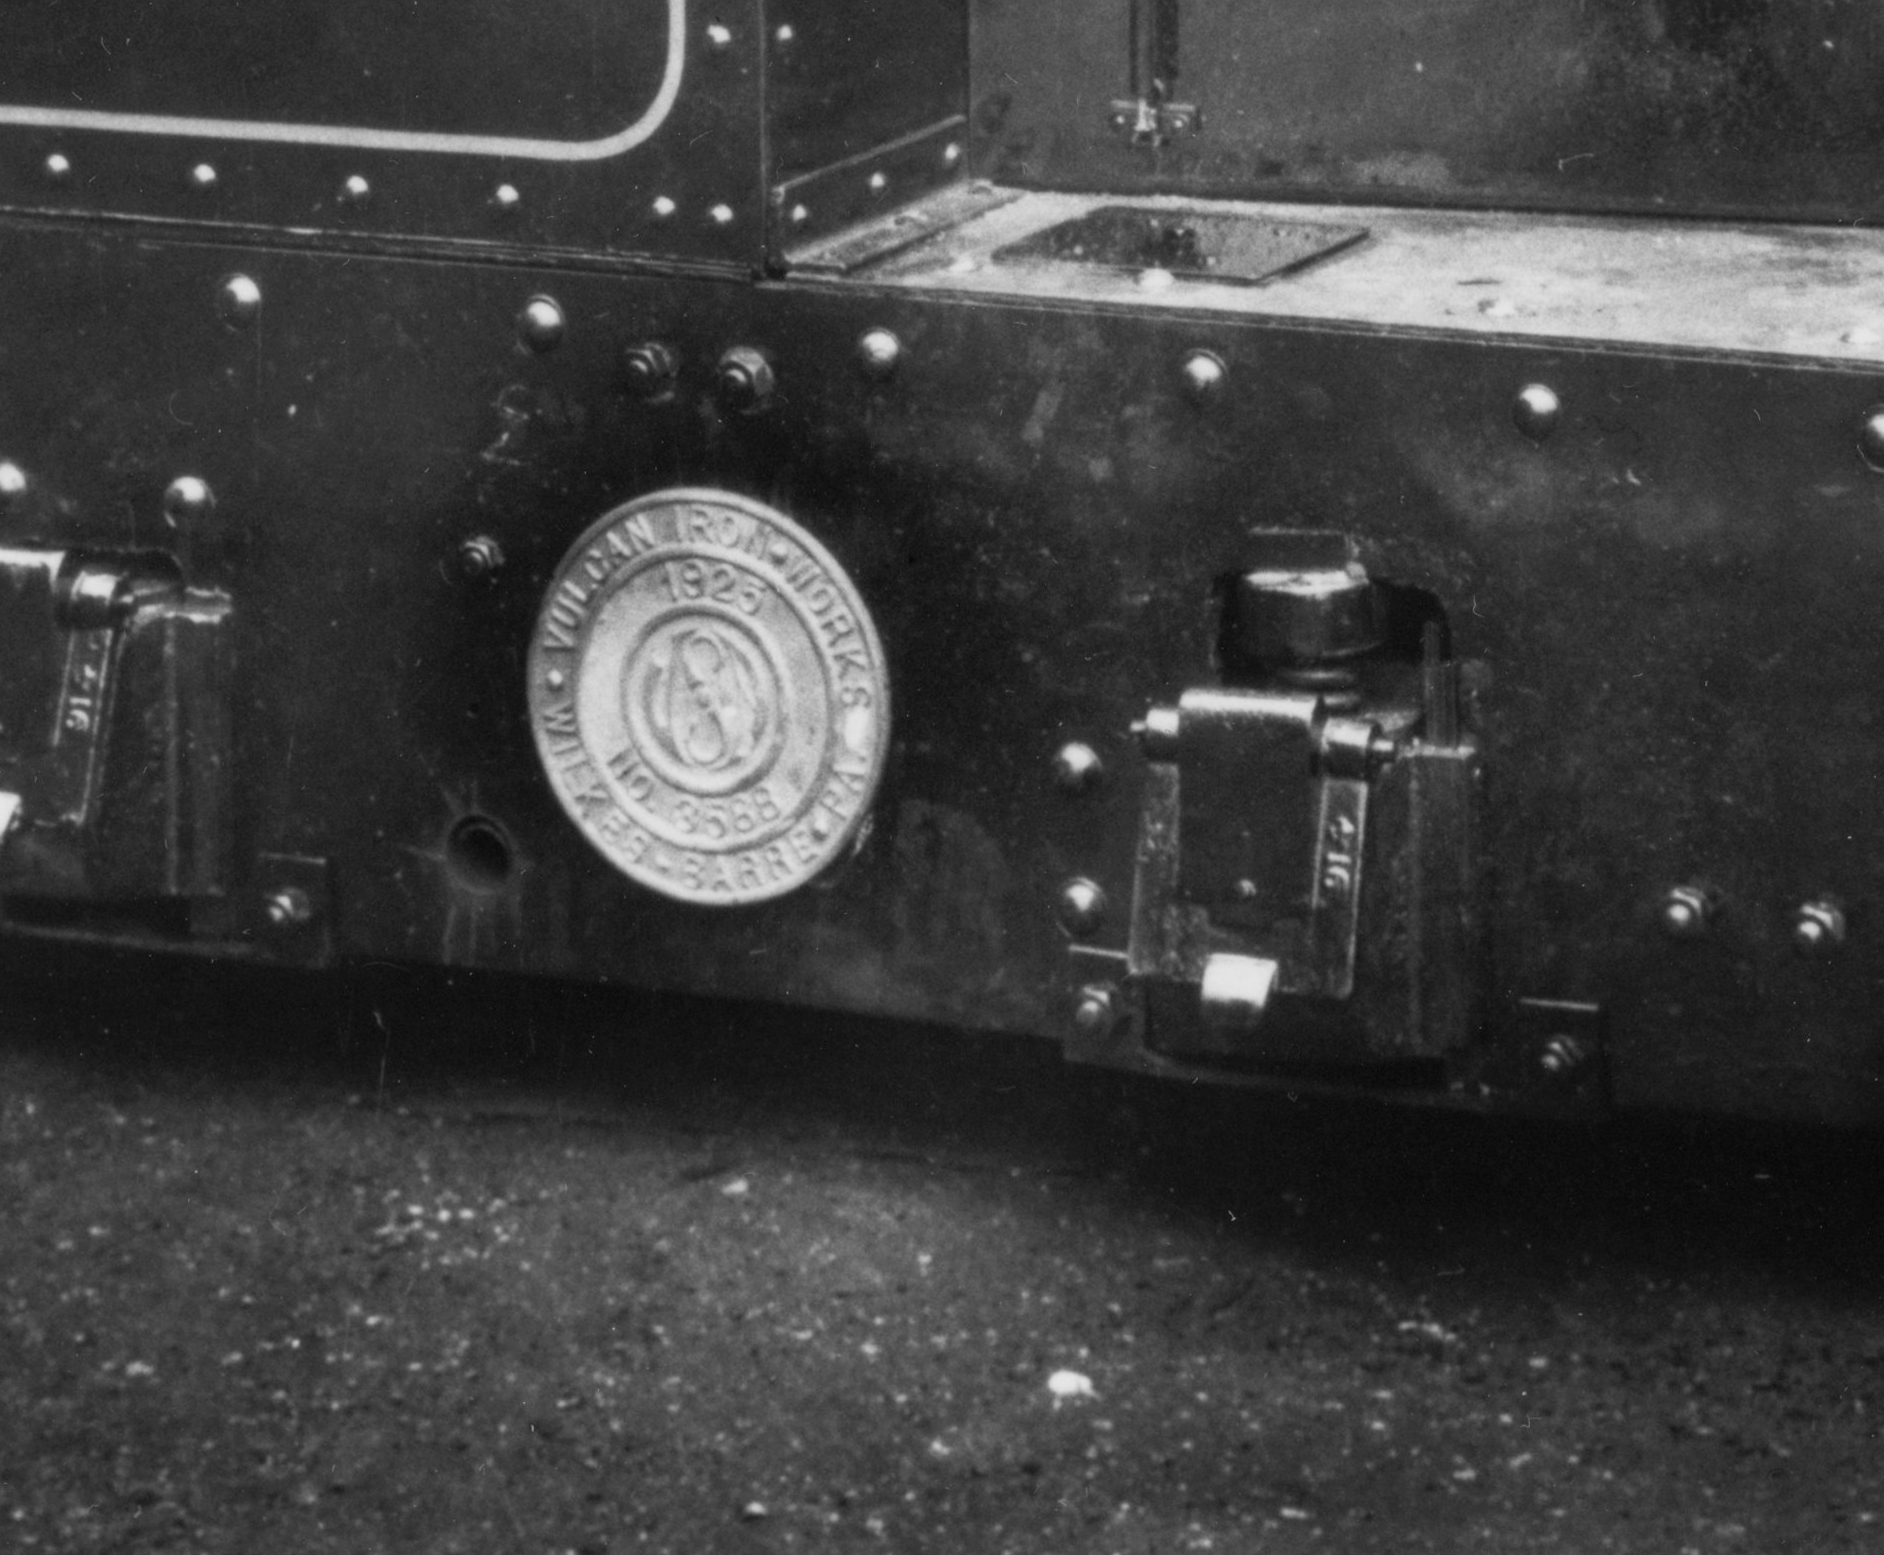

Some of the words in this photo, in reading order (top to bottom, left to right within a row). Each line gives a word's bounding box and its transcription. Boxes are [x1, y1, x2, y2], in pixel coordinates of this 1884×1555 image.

[543, 512, 656, 650] VULCAN
[674, 504, 778, 561] IRON
[785, 547, 874, 710] WORKS
[662, 562, 768, 617] 1925
